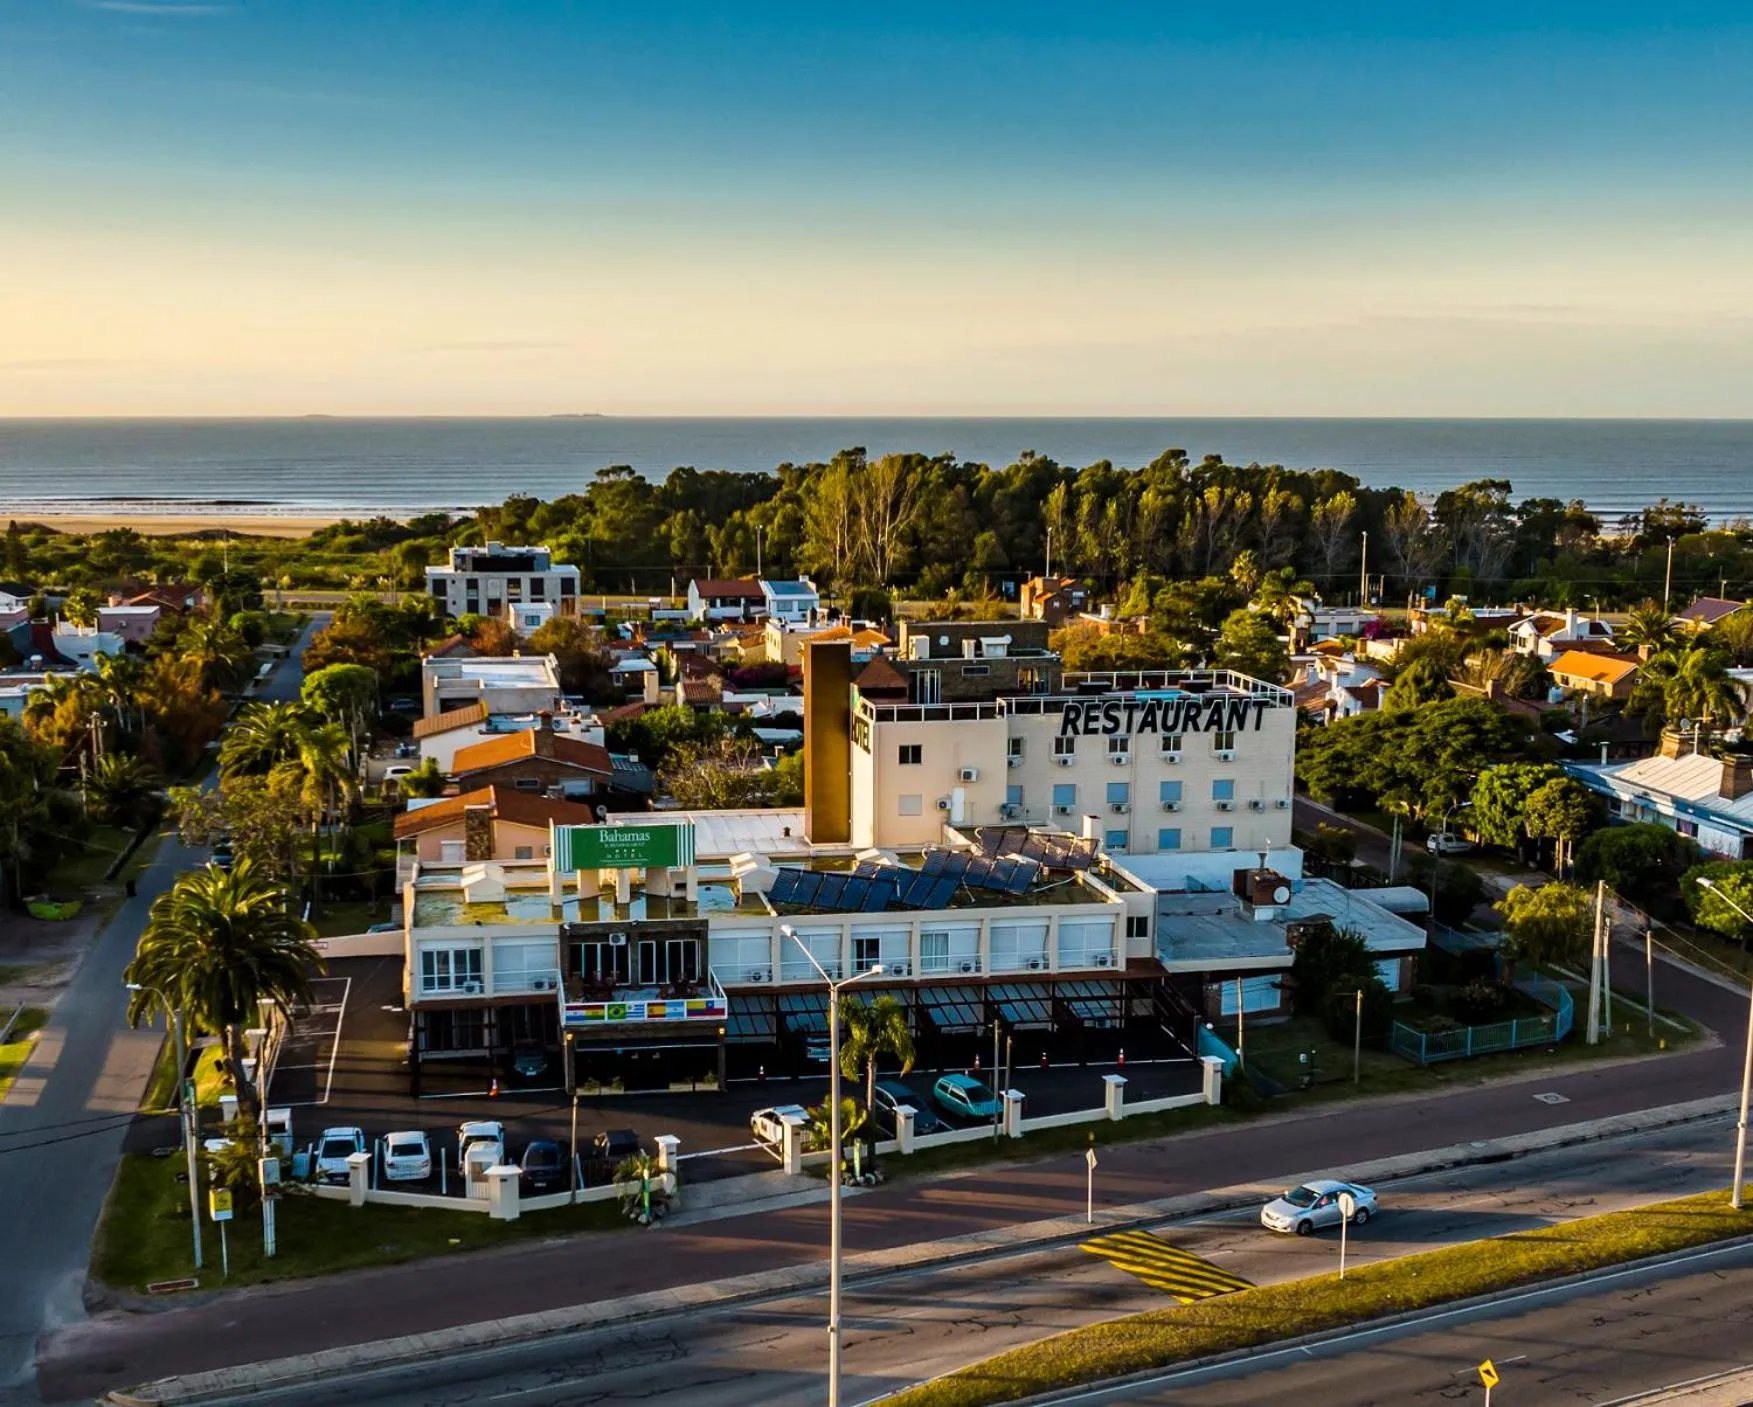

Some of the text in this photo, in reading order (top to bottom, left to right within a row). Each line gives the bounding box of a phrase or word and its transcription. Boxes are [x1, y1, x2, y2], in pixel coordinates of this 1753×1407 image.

[852, 711, 871, 755] HOTEL
[1060, 699, 1270, 736] RESTAURANT
[599, 829, 651, 843] Bahamas
